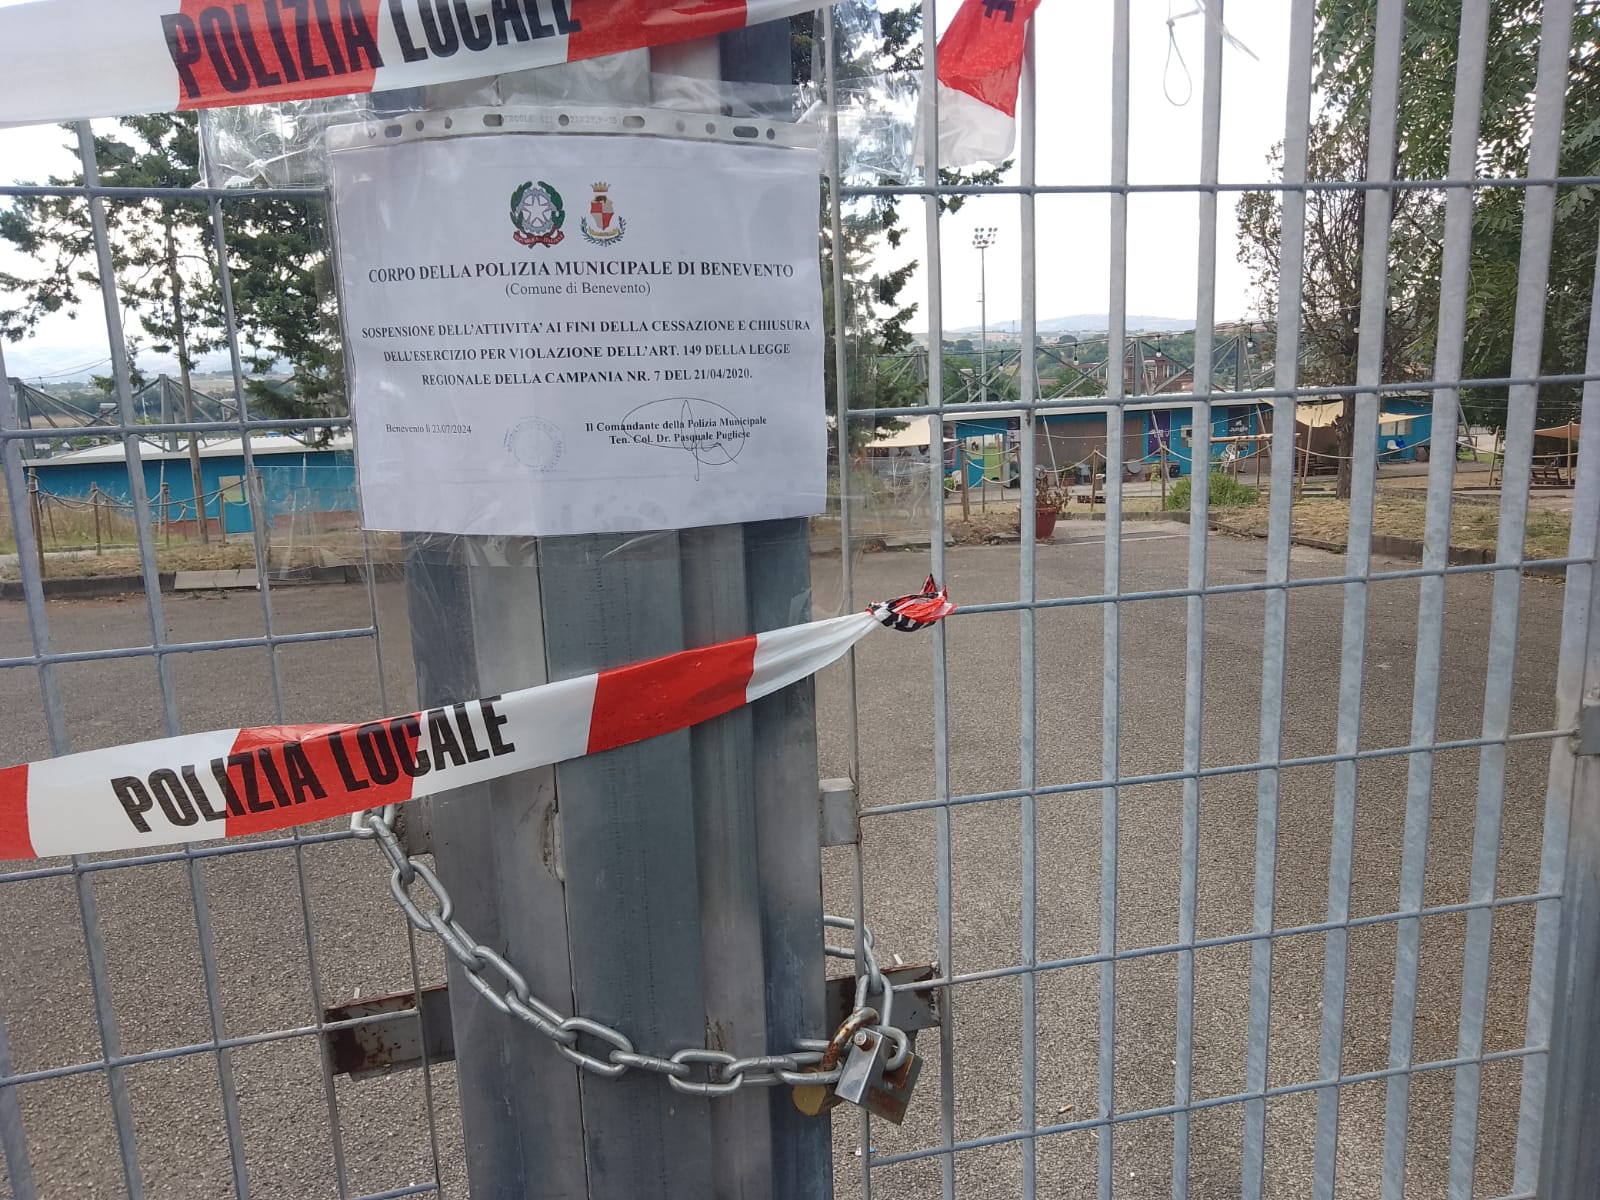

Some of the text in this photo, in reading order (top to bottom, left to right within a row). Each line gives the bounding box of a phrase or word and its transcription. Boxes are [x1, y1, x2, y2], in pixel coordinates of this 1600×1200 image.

[160, 0, 384, 98] POLIZIA
[368, 261, 794, 283] CORPO DELLA POLIZIA MUNICIPALE DI BENEVENTO
[505, 281, 651, 297] (Comune di Benevento)
[362, 325, 436, 339] SOSPENSIONE
[546, 322, 562, 333] AI
[566, 321, 596, 333] FINI
[600, 320, 649, 332] DELLA
[651, 319, 735, 332] CESSAZIONE
[738, 320, 746, 331] E
[749, 319, 811, 331] CHIUSURA
[480, 348, 507, 360] PER
[509, 346, 603, 359] VIOLAZIONE
[683, 344, 702, 356] 149
[705, 344, 747, 356] DELLA
[749, 344, 791, 355] LEGGE
[422, 368, 752, 386] REGIONALE DELLA CAMPANIA NR. 7 DEL 21/04/2020.
[386, 423, 425, 433] Benevento
[586, 415, 768, 432] Il Comandante della Polizia Municipale
[608, 429, 751, 445] Ten. Col. Dr. Pasquale Pugliese
[110, 694, 516, 833] POLIZIA LOCALE
